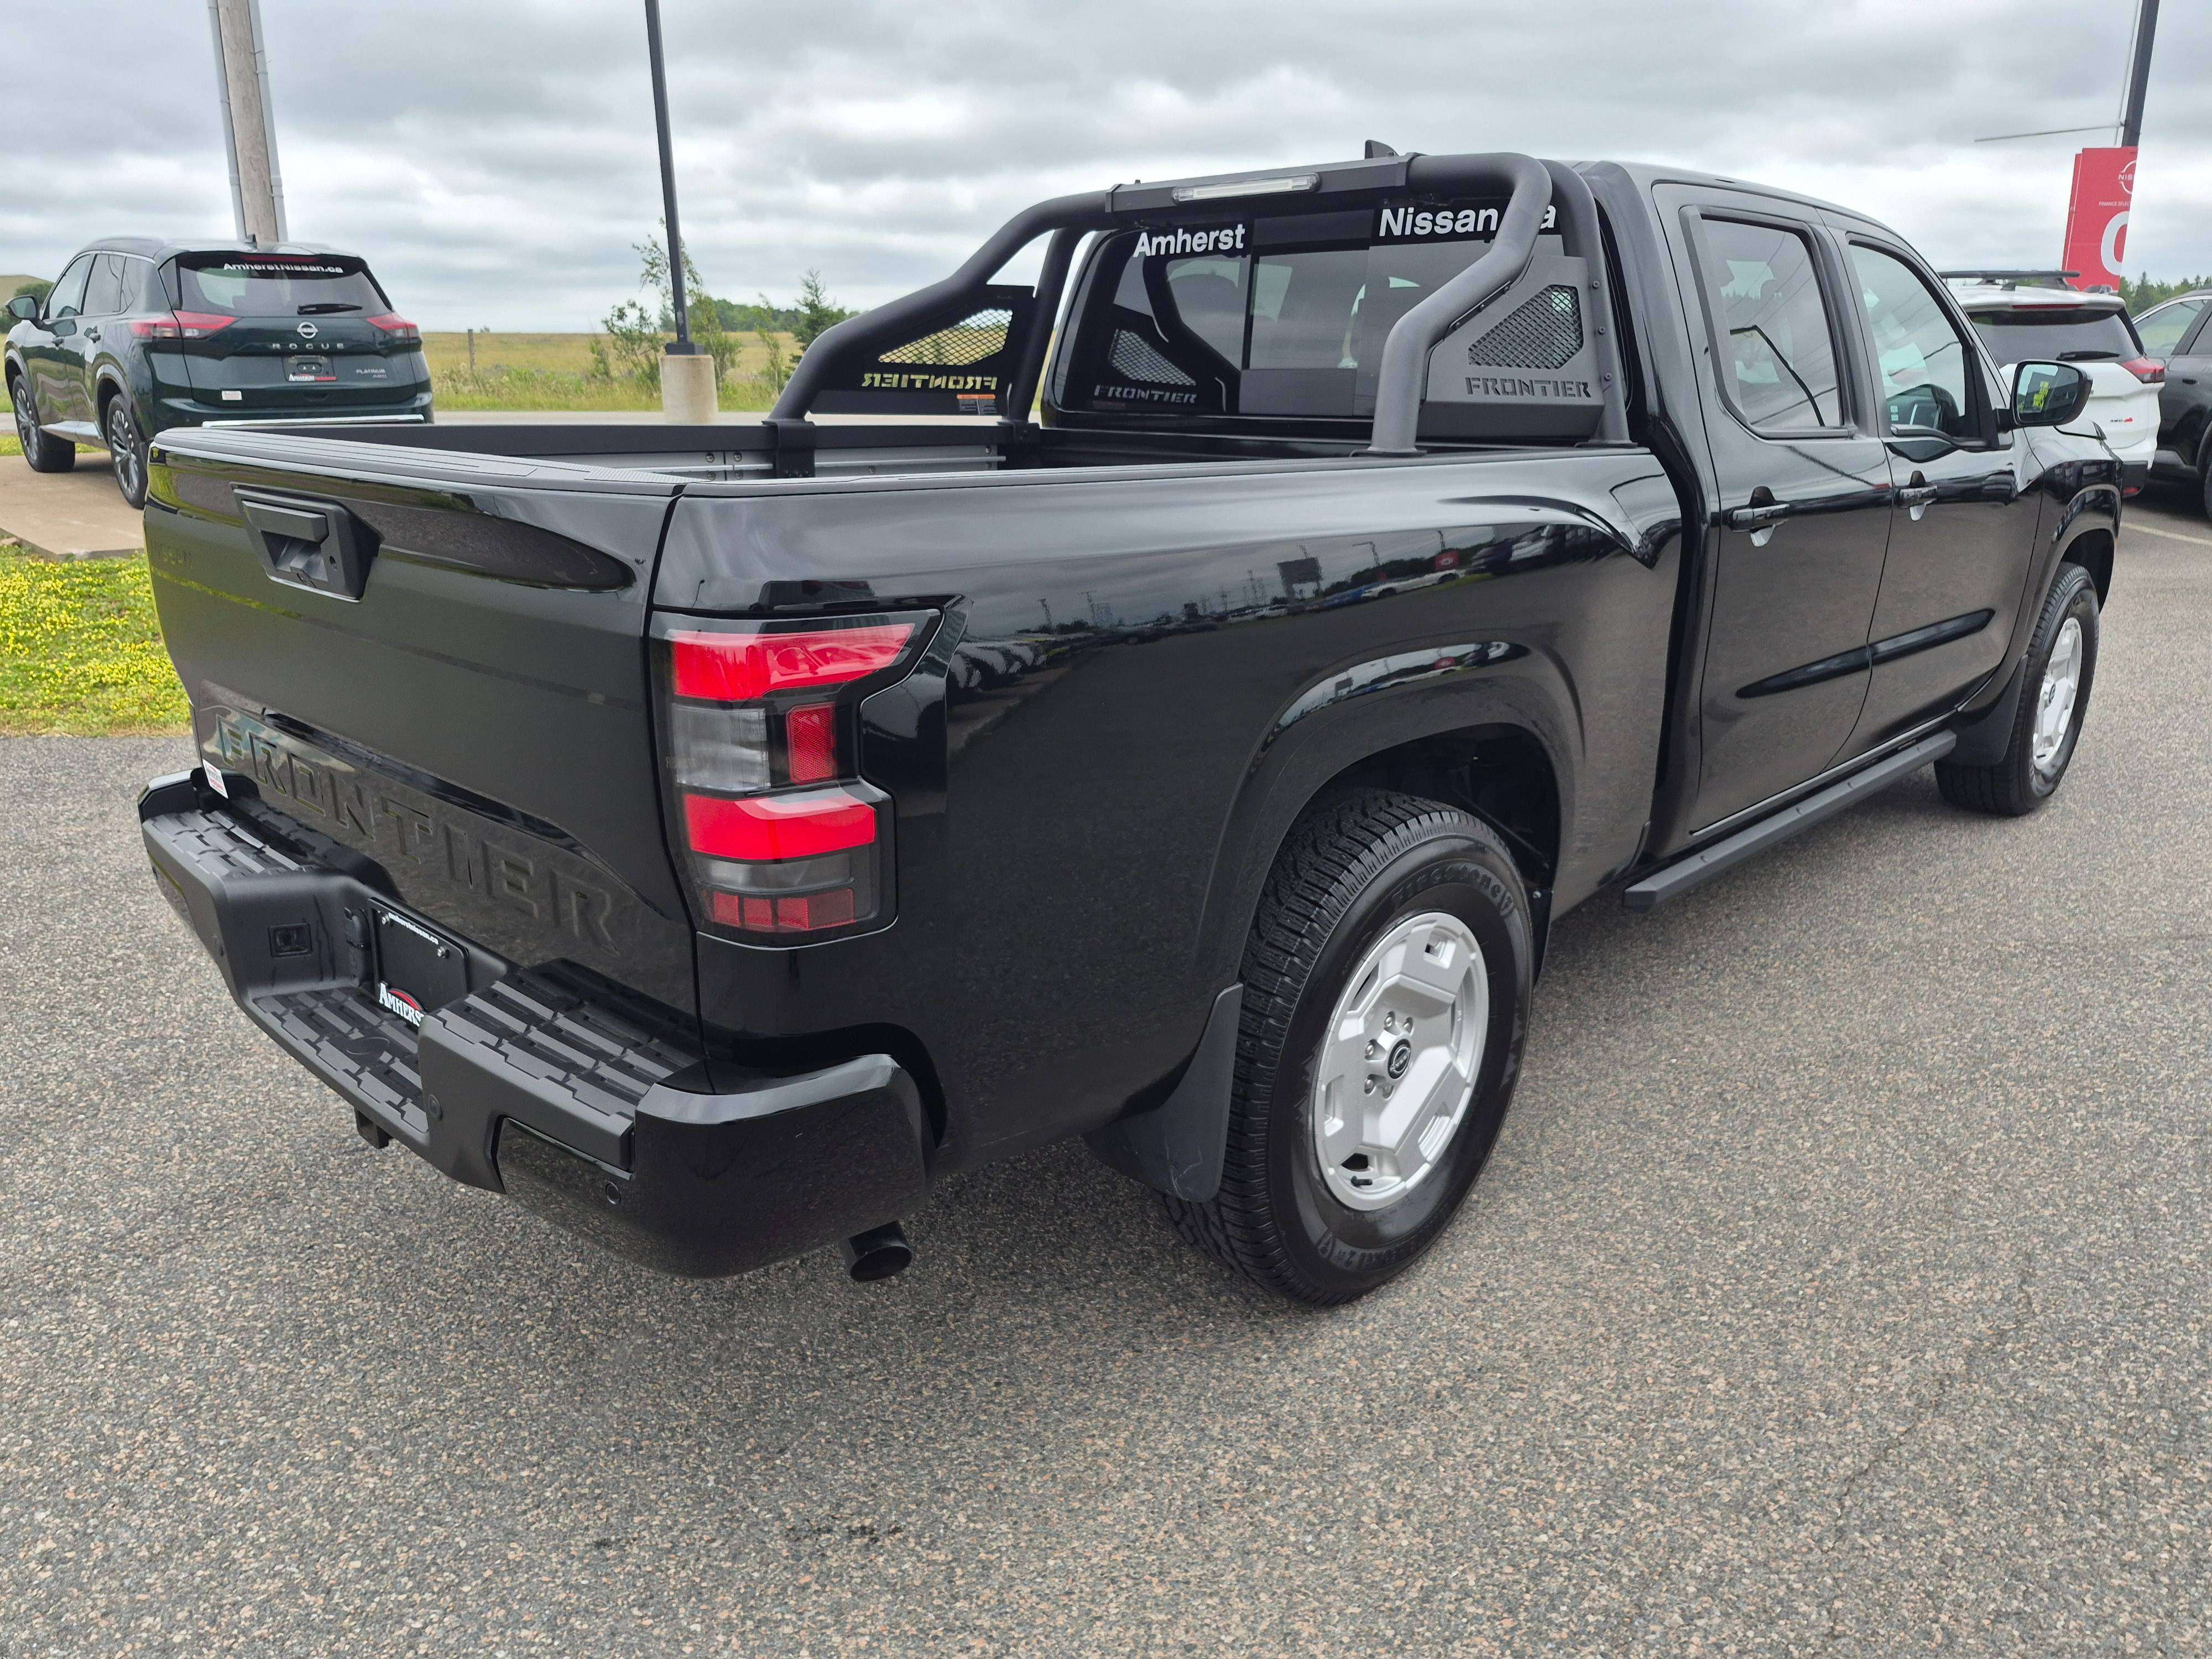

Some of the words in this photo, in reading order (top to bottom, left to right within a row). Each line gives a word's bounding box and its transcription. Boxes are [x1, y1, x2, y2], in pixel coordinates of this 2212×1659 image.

[1133, 223, 1245, 258] Amherst
[1379, 205, 1556, 237] Nissana
[223, 263, 344, 273] AmherstNissan.ca
[1094, 385, 1197, 404] FRONTIER
[1465, 377, 1592, 398] FRONTIER
[215, 713, 620, 956] FRONTIER
[379, 982, 425, 1027] AMHERS
